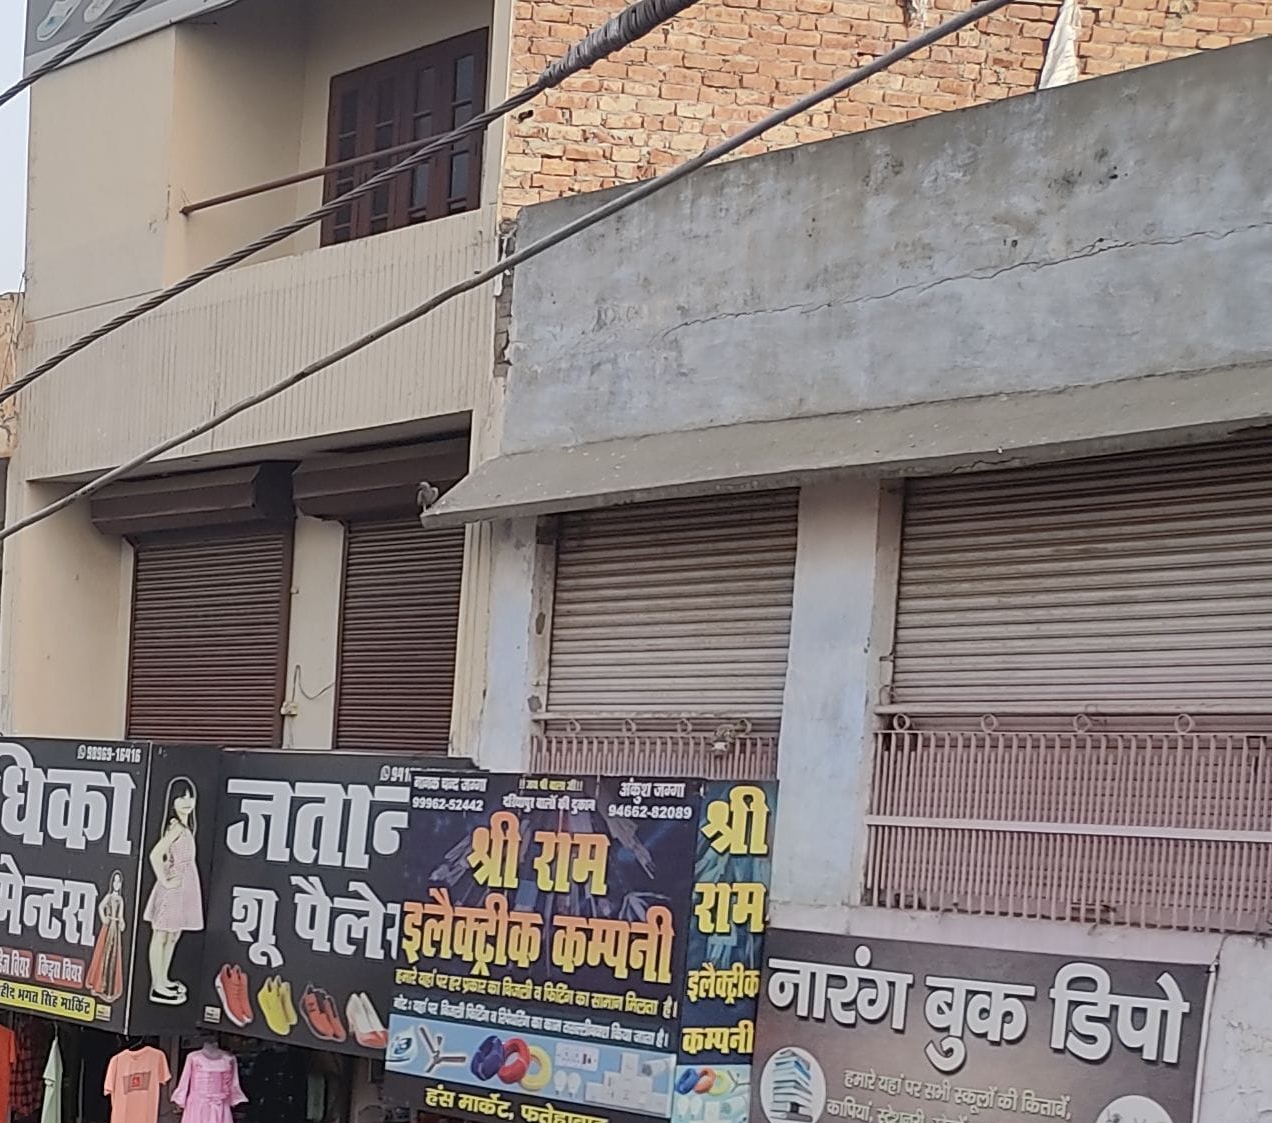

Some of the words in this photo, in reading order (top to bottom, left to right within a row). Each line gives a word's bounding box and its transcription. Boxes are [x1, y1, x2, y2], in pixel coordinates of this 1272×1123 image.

[412, 796, 484, 811] 99962-52442
[619, 777, 652, 803] अंकुश
[608, 804, 693, 819] 94662-82089
[700, 785, 768, 856] श्री
[467, 810, 521, 890] श्री
[533, 830, 612, 896] राम
[232, 886, 284, 968] शू
[694, 882, 767, 934] राम
[552, 906, 675, 983] कम्पनी
[17, 988, 39, 1004] भगत
[40, 989, 59, 1008] सिंह
[60, 995, 92, 1016] मार्किट
[575, 990, 590, 1007] का
[591, 992, 624, 1011] सामान
[624, 990, 659, 1015] मिलता
[768, 946, 913, 1031] नारंग
[924, 974, 1037, 1072] बुक
[1050, 962, 1191, 1065] डिपो
[682, 1019, 754, 1054] कम्पनी
[425, 1084, 455, 1108] हंस
[844, 1068, 876, 1090] हमारे
[878, 1073, 904, 1095] यहां
[905, 1080, 922, 1098] पर
[924, 1077, 952, 1102] सभी
[954, 1086, 997, 1115] स्कूलों
[997, 1089, 1018, 1111] की
